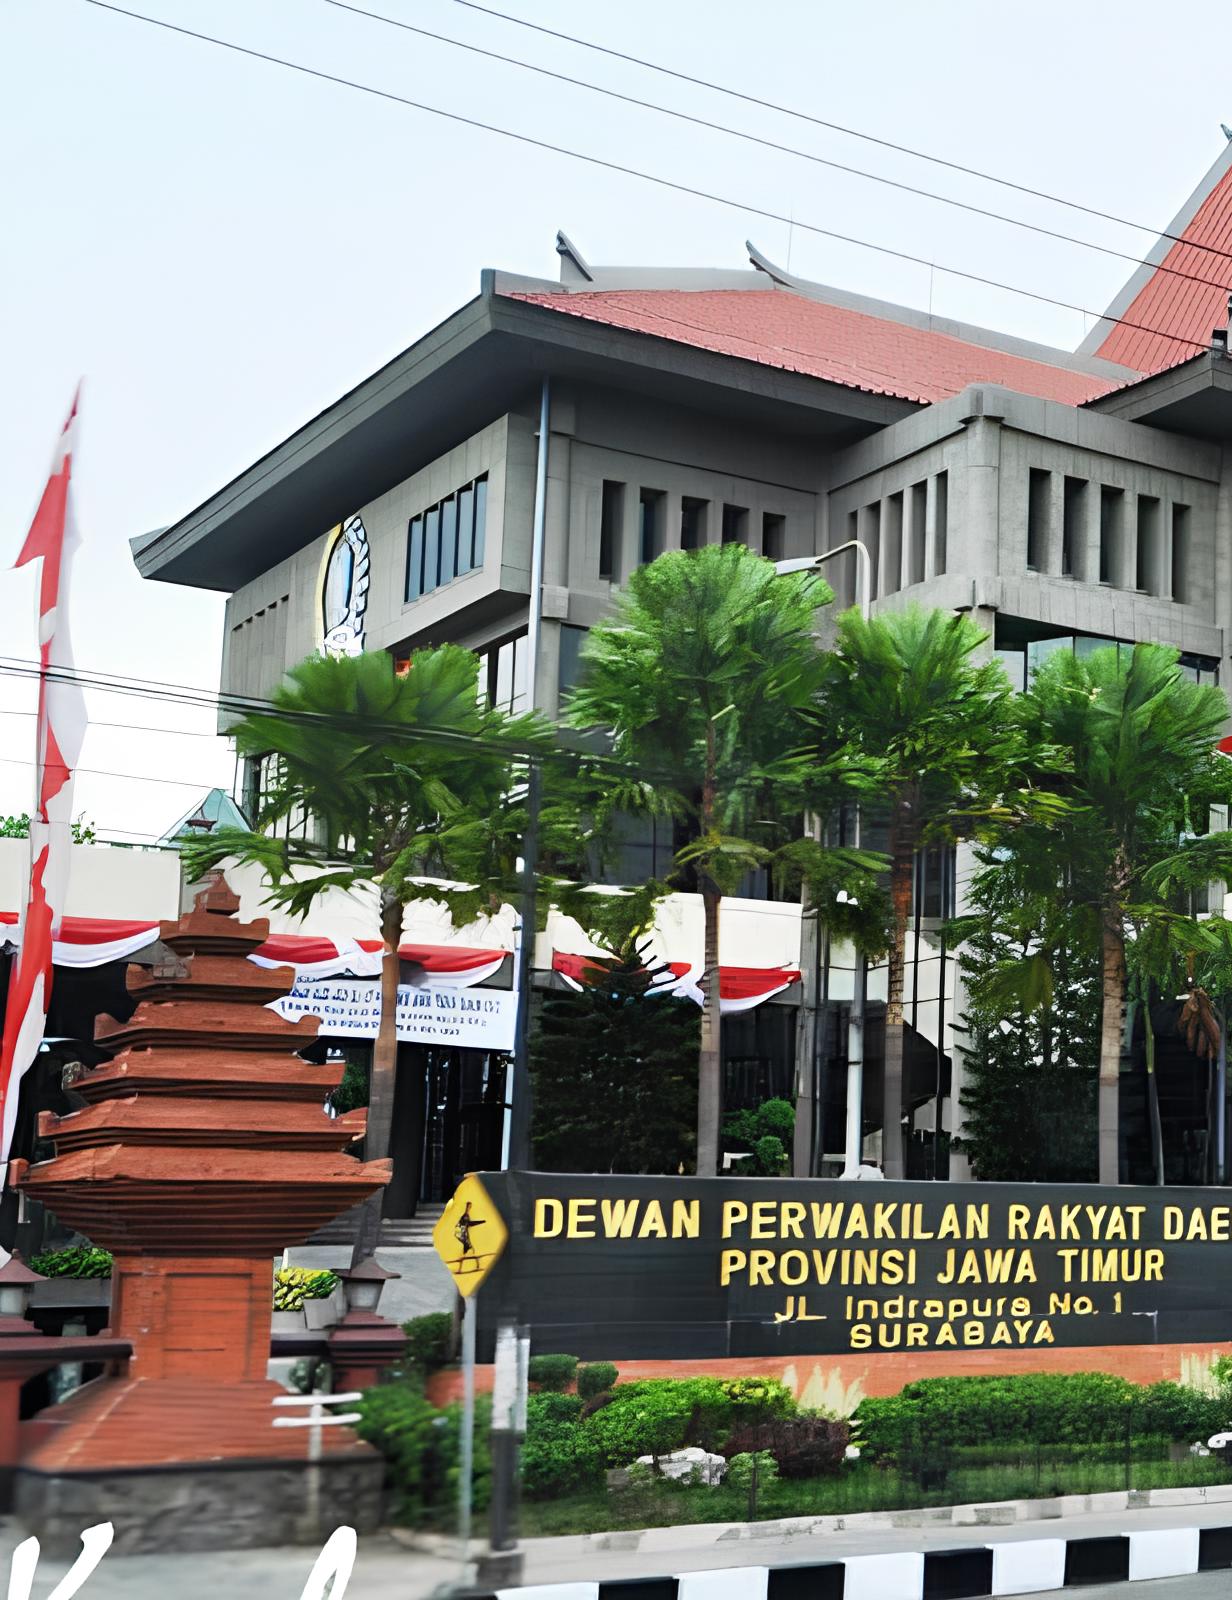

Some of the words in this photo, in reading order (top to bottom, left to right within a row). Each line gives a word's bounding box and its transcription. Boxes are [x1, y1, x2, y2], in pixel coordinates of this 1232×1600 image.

[532, 1197, 702, 1240] DEWAN
[720, 1199, 991, 1240] PERWAKILAN
[1007, 1202, 1148, 1242] RAKYAT
[719, 1248, 919, 1288] PROVINSI
[935, 1247, 1039, 1285] JAWA
[1055, 1247, 1166, 1284] TIMUR
[1113, 1290, 1123, 1315] 1
[849, 1318, 1056, 1350] SURABAYA
